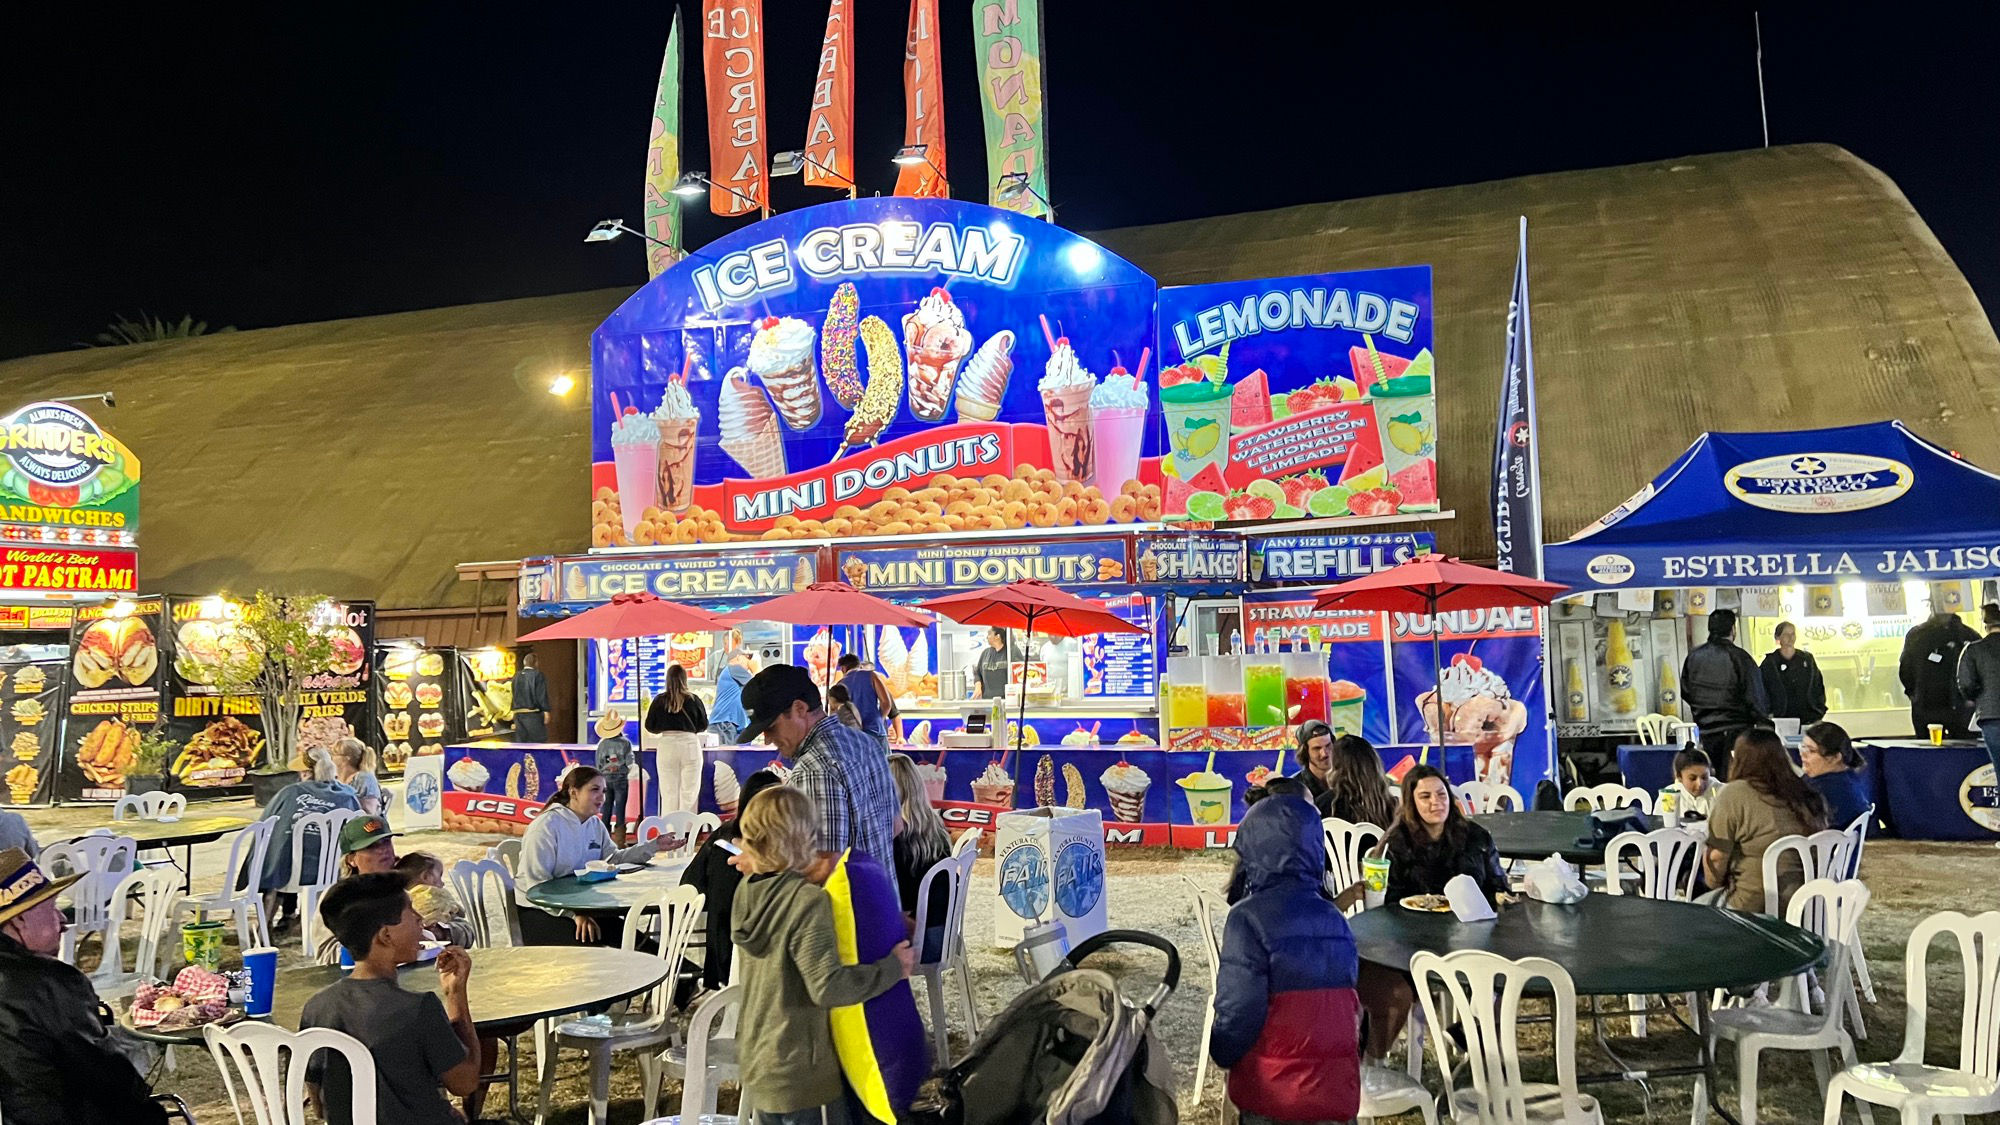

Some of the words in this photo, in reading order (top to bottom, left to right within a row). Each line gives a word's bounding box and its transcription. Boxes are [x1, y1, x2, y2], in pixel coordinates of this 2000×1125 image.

[694, 239, 794, 311] ICE
[800, 224, 1022, 284] CREAM
[1174, 290, 1418, 359] LEMONADE
[29, 408, 60, 423] ALWAYS
[60, 410, 85, 429] FRESH
[1237, 411, 1350, 449] STAWBERRY
[0, 423, 115, 463] GRINDERS
[1232, 419, 1367, 461] WATERMELON
[1248, 432, 1357, 468] LEMONADE
[19, 456, 50, 479] ALWAYS
[51, 461, 91, 481] DELICIOUS
[1262, 445, 1347, 474] LIMEADE
[733, 479, 825, 523] MINI
[833, 434, 1001, 500] DONUTS
[1755, 473, 1879, 488] ESTRELLA
[1770, 482, 1868, 495] JALISCO
[1151, 542, 1186, 550] CHOCOLATE
[1267, 538, 1297, 547] ANY
[1300, 537, 1324, 547] SIZE
[1329, 537, 1347, 546] UP
[1353, 536, 1371, 545] TO
[1374, 535, 1391, 544] 44
[6, 550, 65, 564] World's
[66, 553, 99, 566] Best
[917, 550, 943, 559] MINI
[945, 549, 987, 557] DONUT
[989, 547, 1041, 556] SUNDAES
[1268, 546, 1411, 578] REFILLS
[601, 563, 661, 573] CHOCOLATE
[674, 561, 717, 570] TWISTED
[729, 558, 775, 567] VANILLA
[869, 560, 945, 586] MINI
[953, 555, 1096, 583] DONUTS
[1157, 552, 1238, 578] SHAKES
[1661, 552, 1861, 579] ESTRELLA
[0, 564, 18, 587] T
[22, 565, 133, 590] PASTRAMI
[588, 573, 647, 596] ICE
[655, 568, 790, 594] CREAM
[1105, 597, 1128, 608] MENU
[1394, 606, 1534, 636] SUNDAE
[1873, 624, 1909, 638] SELTZE
[70, 702, 118, 715] CHICKEN
[121, 701, 159, 714] STRIPS
[174, 697, 221, 717] DIRTY
[320, 690, 367, 704] VERDE
[122, 714, 129, 723] &
[131, 713, 157, 723] FRIES
[303, 704, 344, 719] FRIES
[1252, 728, 1282, 745] LIMEADE
[465, 799, 515, 816] ICE
[999, 836, 1030, 858] VENTURA
[1072, 834, 1096, 849] COUNTY
[1000, 857, 1049, 895] FAIR
[1056, 849, 1103, 902] FAIR
[244, 966, 255, 1003] pepsi
